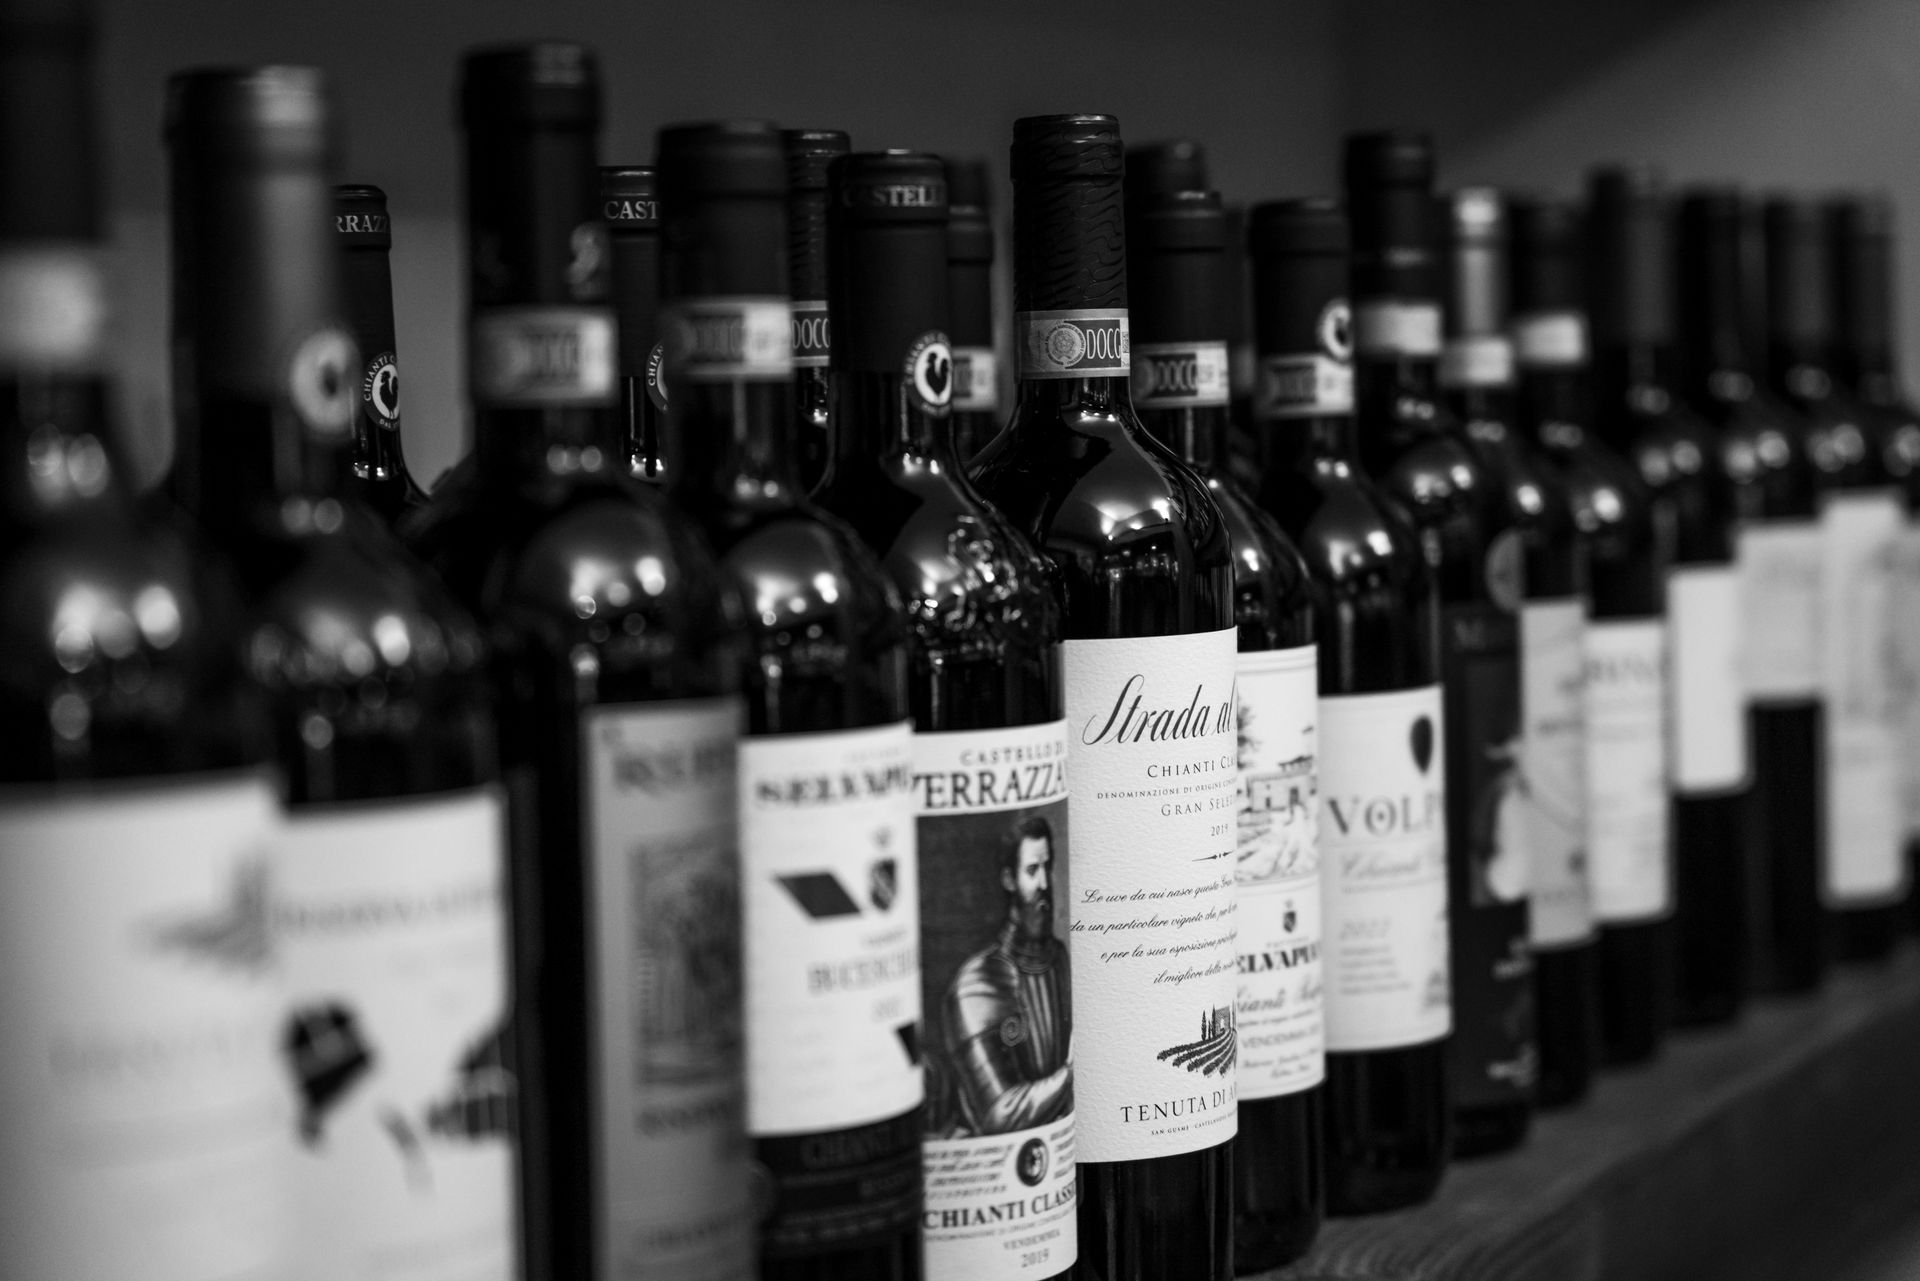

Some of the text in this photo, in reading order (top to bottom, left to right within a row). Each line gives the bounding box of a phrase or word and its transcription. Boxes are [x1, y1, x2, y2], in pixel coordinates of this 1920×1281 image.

[335, 214, 388, 233] RRAZ
[1086, 327, 1121, 360] DOCG
[1082, 673, 1211, 746] Strada
[1147, 758, 1215, 778] CHIANTI
[1097, 787, 1179, 800] DENOMINAZIONE
[1183, 786, 1193, 794] DI
[1195, 782, 1222, 793] ORIGINE
[1161, 802, 1202, 817] GRAN
[1210, 823, 1229, 837] 2019
[1081, 888, 1104, 904] Le
[1105, 894, 1127, 903] uve
[1129, 888, 1146, 901] da
[1148, 888, 1167, 899] cui
[1167, 888, 1193, 898] nasce
[1070, 920, 1085, 932] da
[1087, 923, 1104, 932] un
[1103, 913, 1169, 935] particolare
[1170, 910, 1204, 930] vigneto
[1100, 951, 1107, 960] e
[1105, 949, 1132, 964] per
[1131, 943, 1144, 958] la
[1146, 947, 1168, 957] sua
[1153, 969, 1167, 984] il
[1165, 965, 1203, 986] migliore
[1120, 1094, 1207, 1123] TENUTA
[1212, 1088, 1226, 1109] DI
[922, 1198, 1025, 1231] CHIANTI
